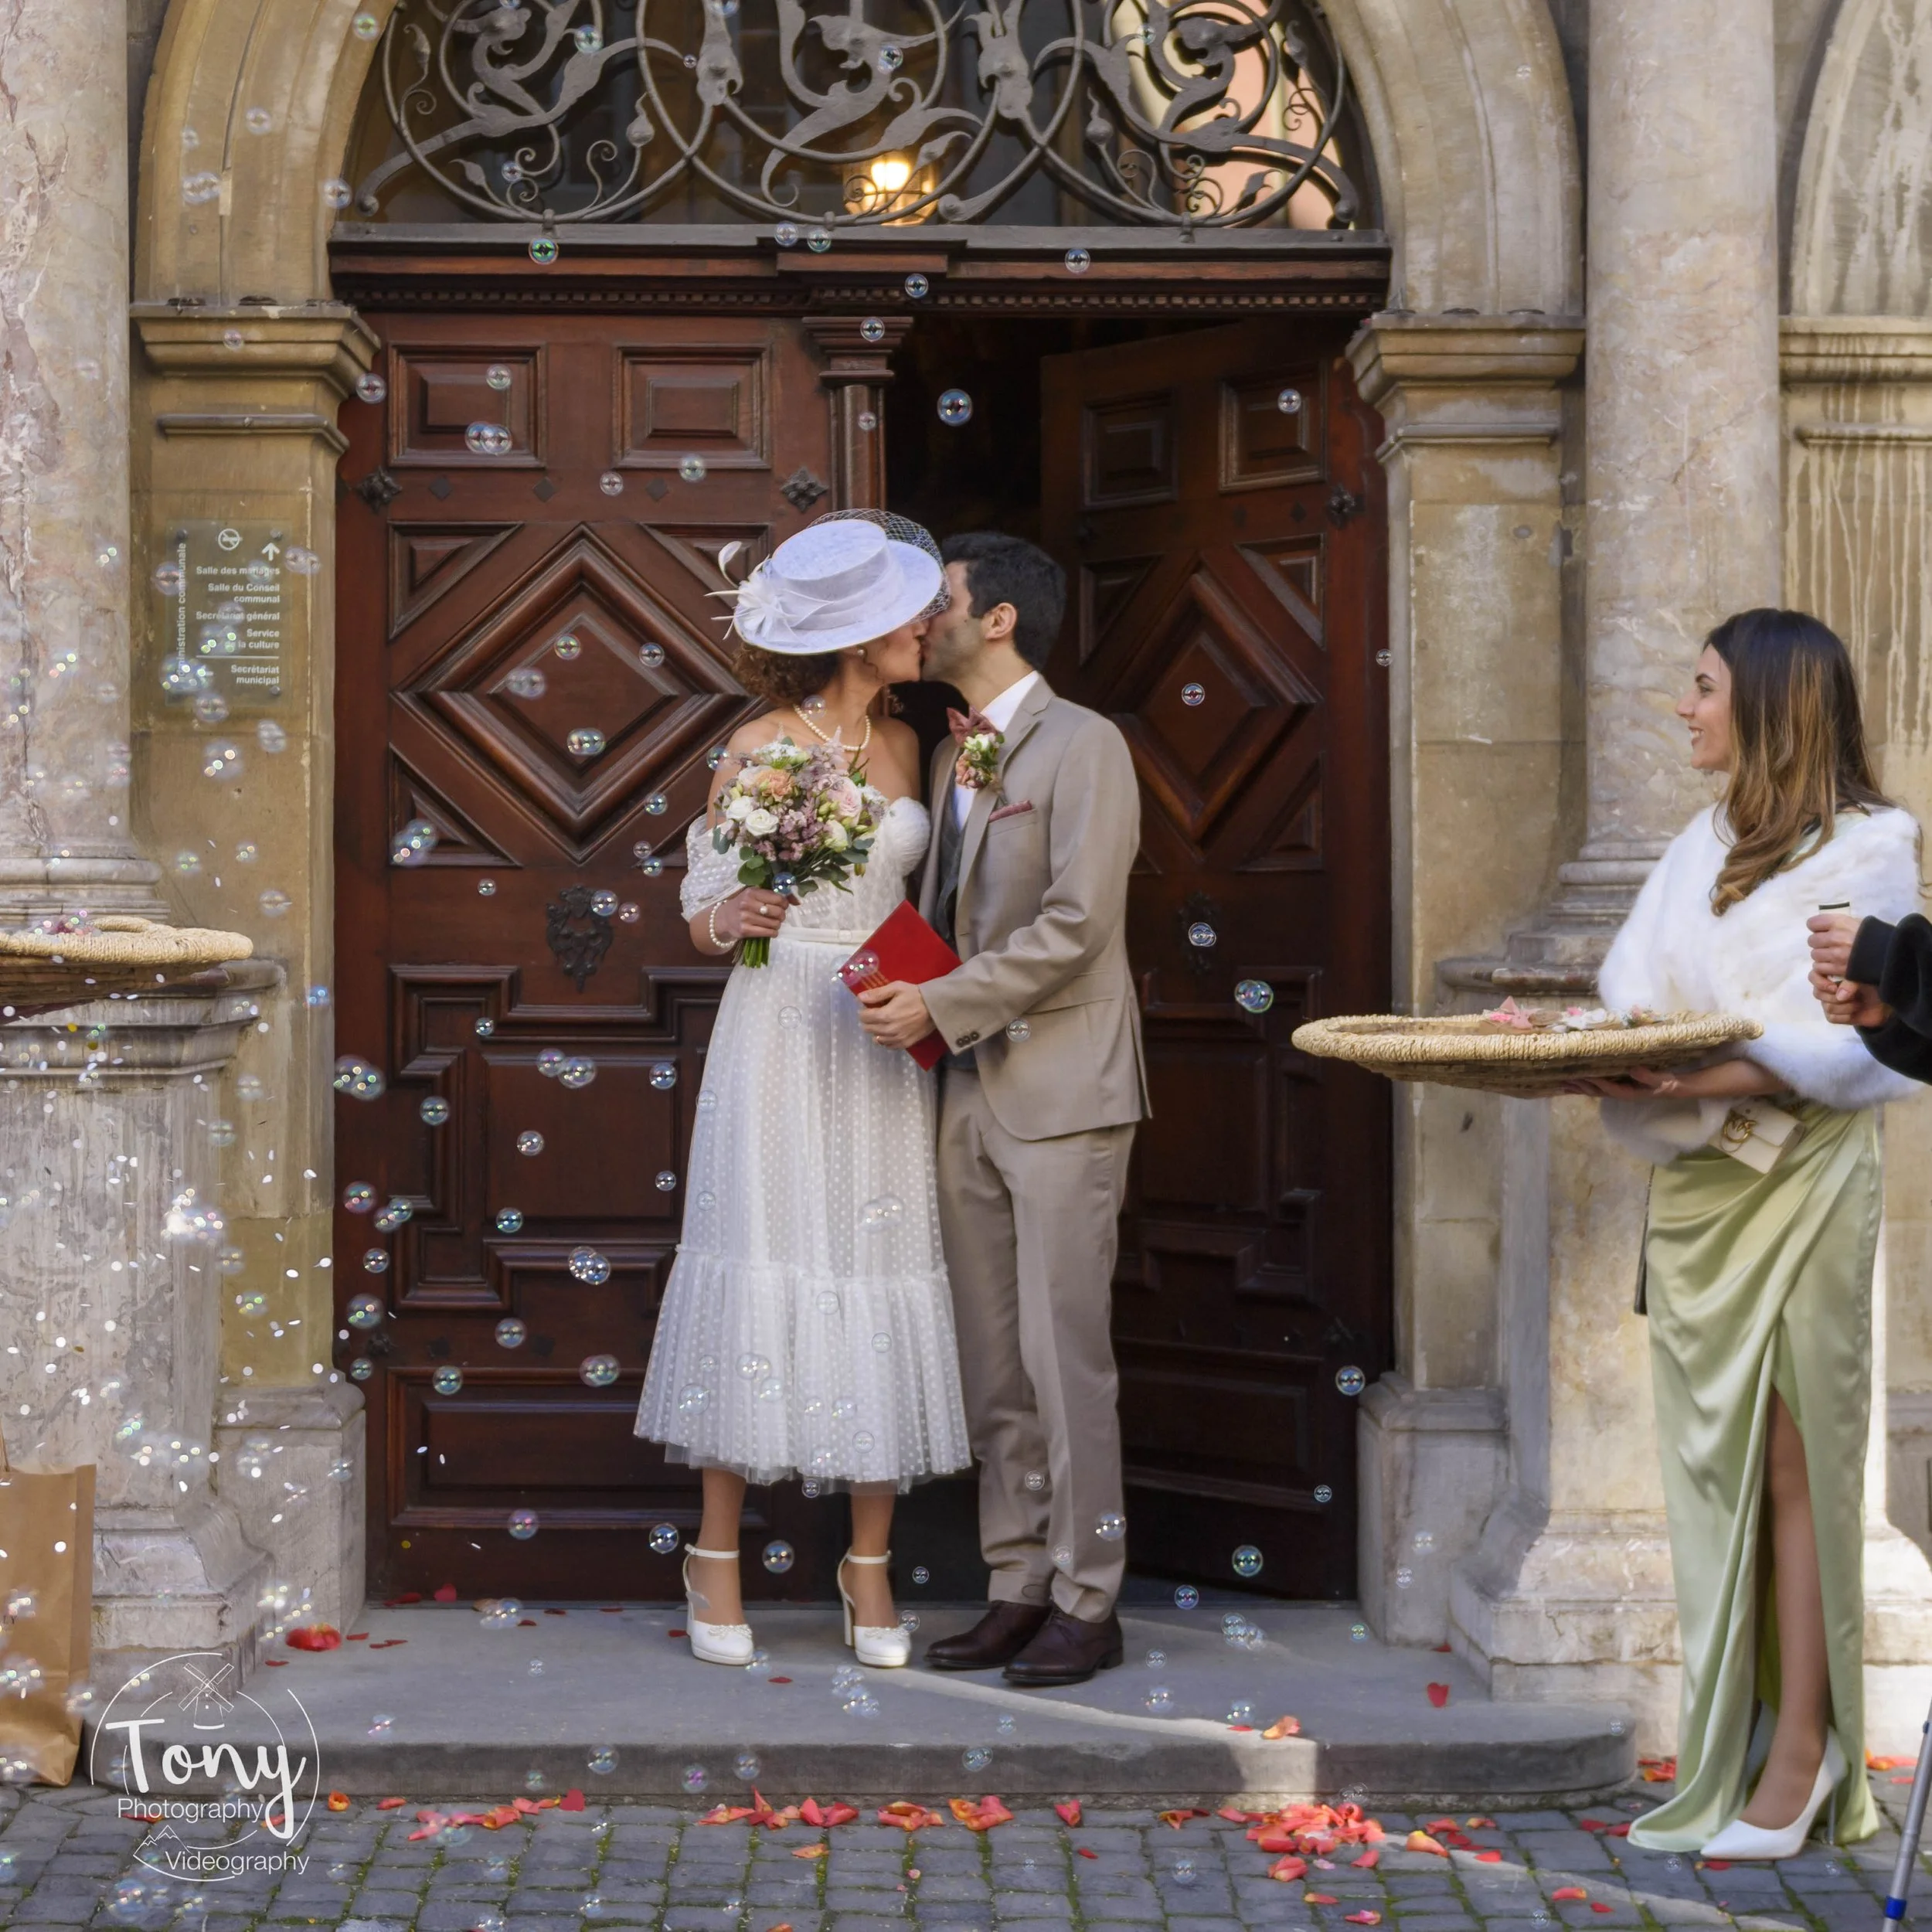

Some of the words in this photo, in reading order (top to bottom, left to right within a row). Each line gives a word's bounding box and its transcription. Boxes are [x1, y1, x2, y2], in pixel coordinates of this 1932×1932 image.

[196, 566, 217, 574] Salle
[221, 566, 236, 574] des
[208, 583, 230, 591] Salle
[233, 583, 243, 591] du
[247, 583, 280, 592] Conseil
[247, 611, 280, 621] général
[247, 628, 280, 638] Service
[238, 640, 246, 648] la
[231, 665, 280, 674] Secrétariat
[236, 676, 280, 685] municipal
